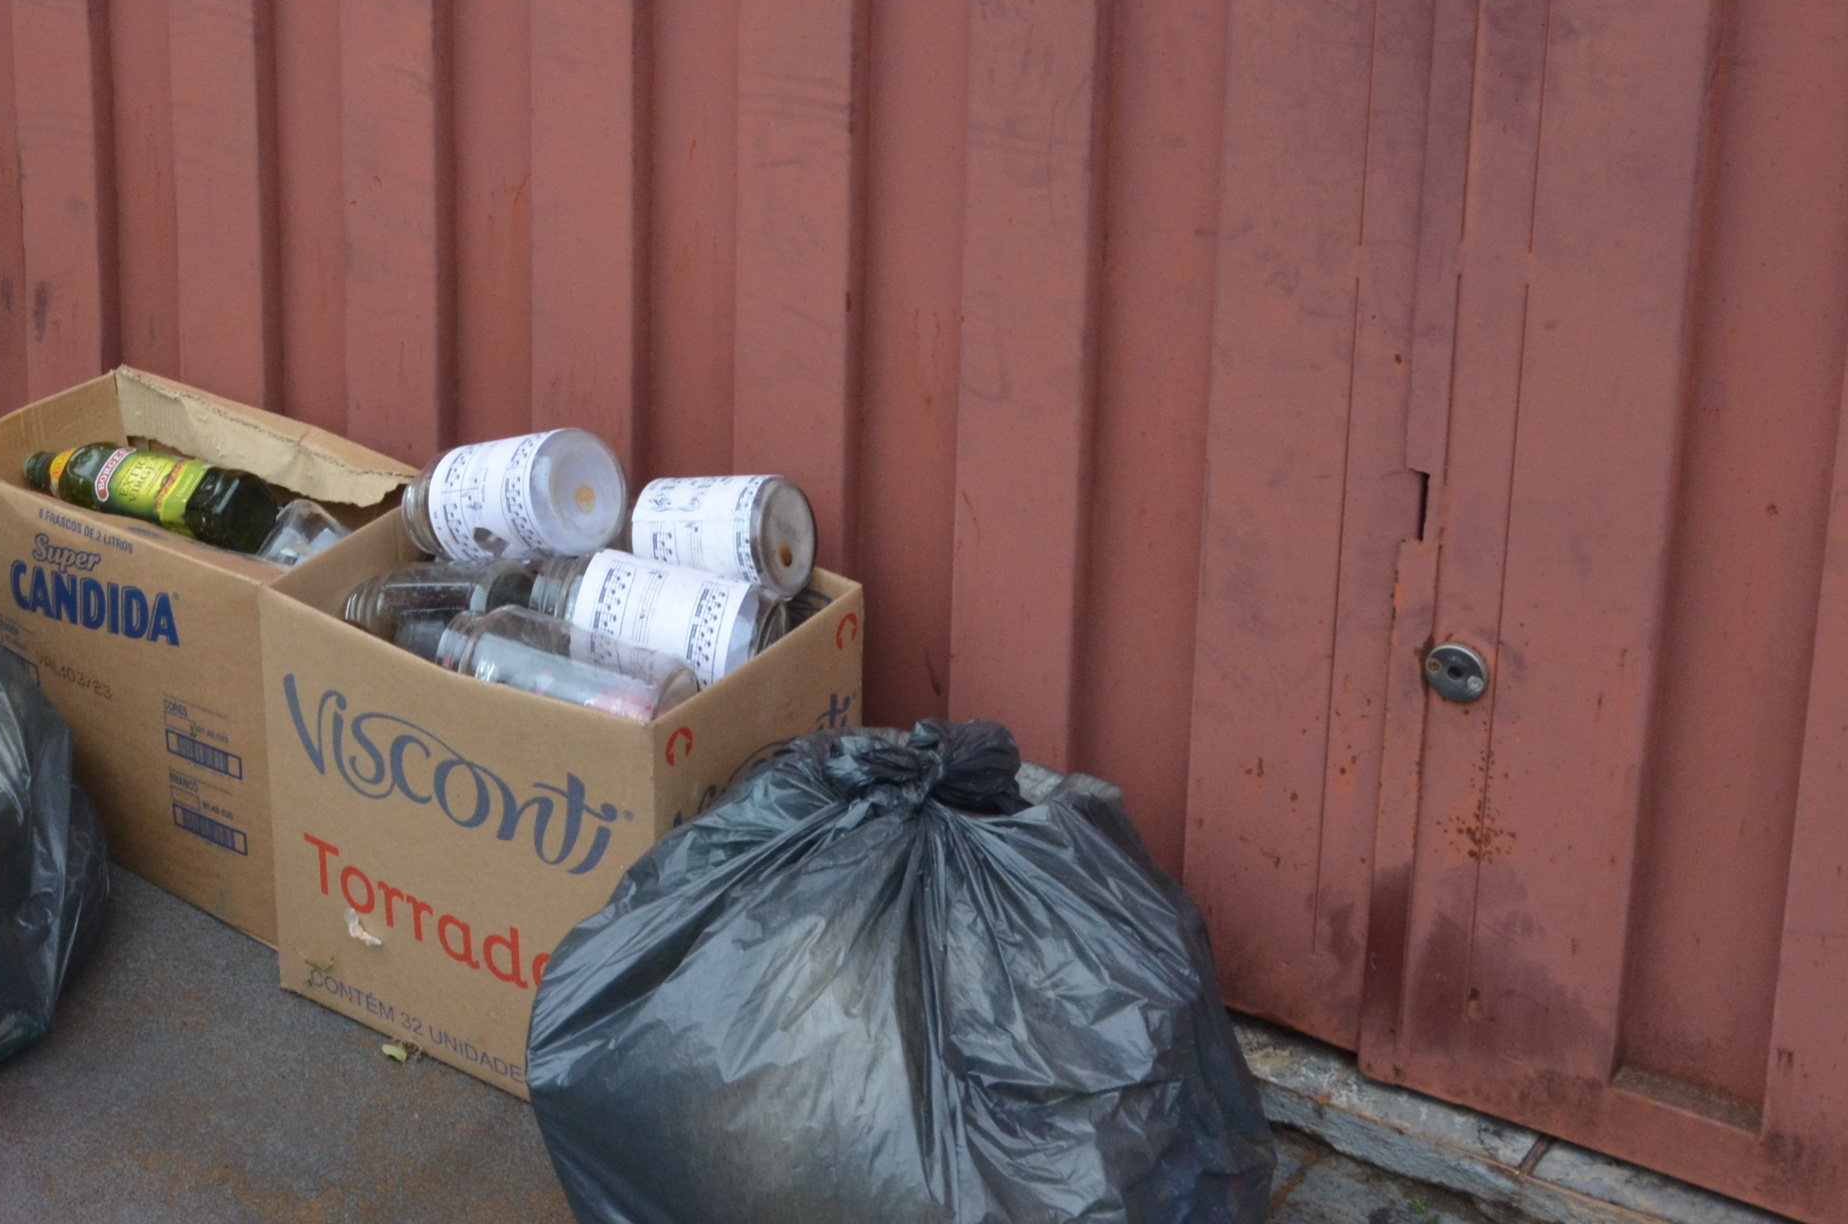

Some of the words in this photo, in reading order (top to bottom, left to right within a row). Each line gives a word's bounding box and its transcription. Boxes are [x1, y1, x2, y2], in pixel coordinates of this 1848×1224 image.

[97, 447, 131, 490] BORGES
[32, 532, 102, 573] Super
[44, 509, 82, 534] FRASCOS
[83, 524, 95, 540] DE
[96, 529, 102, 542] 2
[103, 533, 134, 554] LITROS
[10, 559, 181, 647] CANDIDA
[310, 968, 395, 1022] CONTÉM
[400, 1011, 423, 1037] 32
[428, 1025, 525, 1084] UNIDADE
